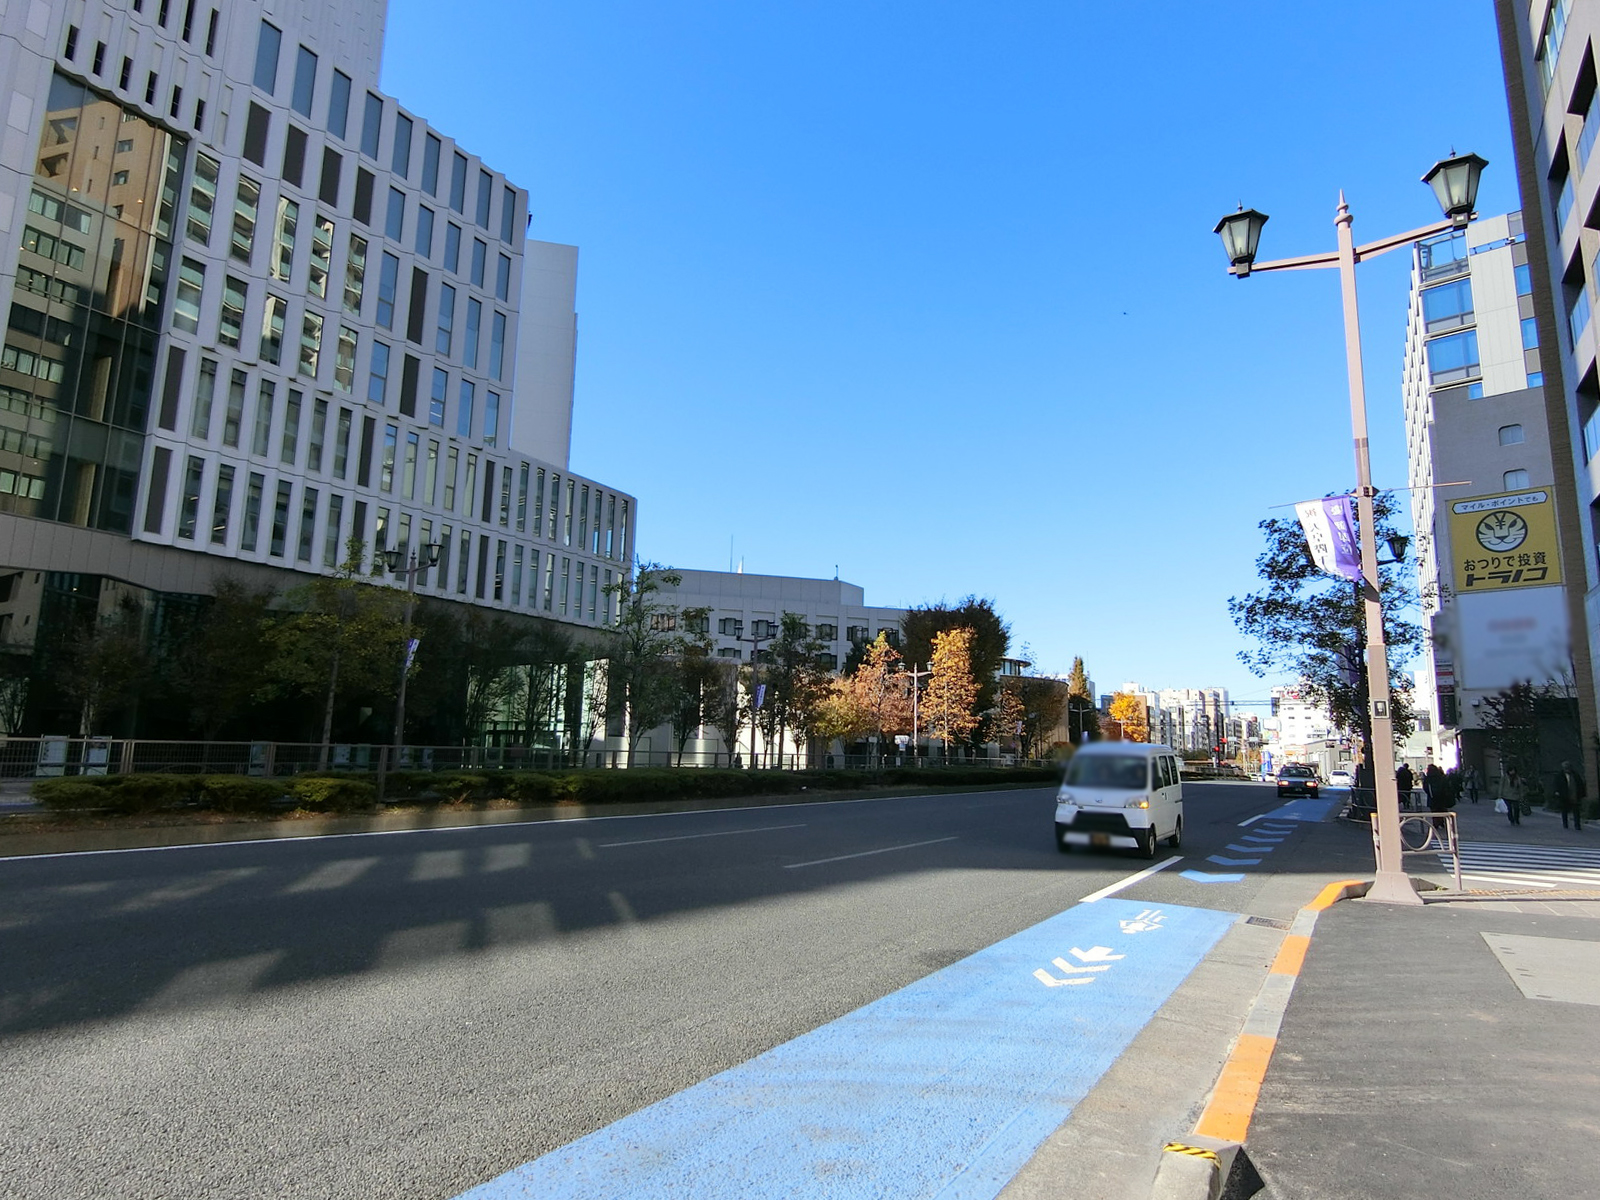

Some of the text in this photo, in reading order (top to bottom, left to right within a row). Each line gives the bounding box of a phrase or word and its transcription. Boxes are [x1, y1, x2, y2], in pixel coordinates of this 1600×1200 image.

[1464, 552, 1547, 571] おつりで投資
[1466, 567, 1548, 587] トラノコ
